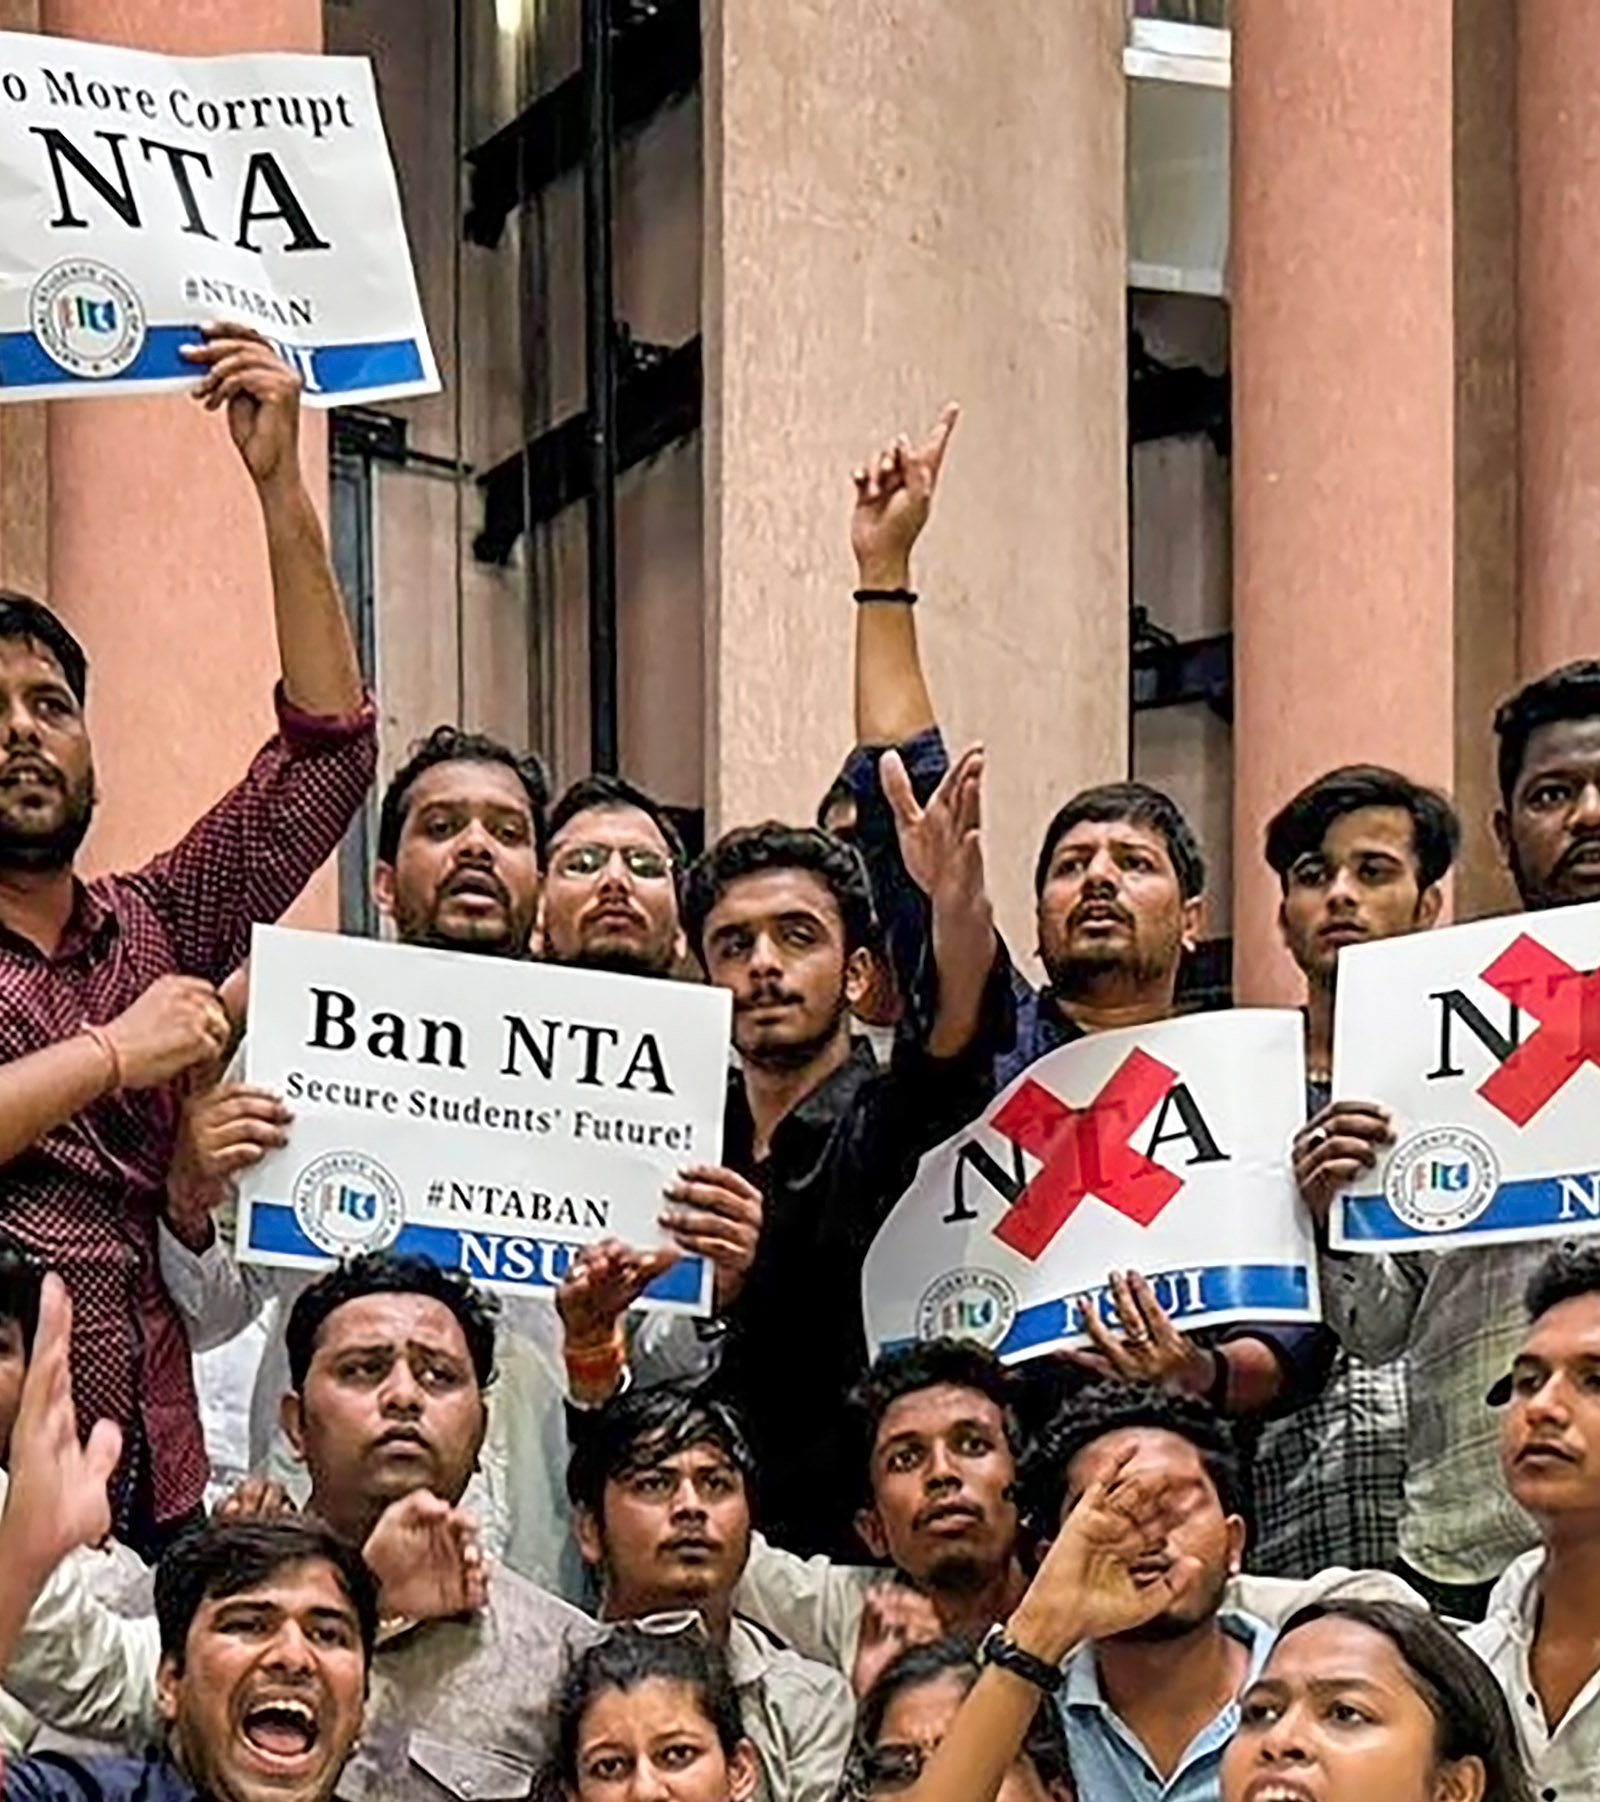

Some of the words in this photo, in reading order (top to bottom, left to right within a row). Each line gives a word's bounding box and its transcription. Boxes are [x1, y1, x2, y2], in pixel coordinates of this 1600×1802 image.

[41, 68, 157, 119] More
[170, 89, 356, 137] Corrupt
[30, 126, 331, 253] NTA
[185, 276, 314, 325] #NTABAN
[307, 988, 466, 1069] Ban
[500, 1015, 674, 1095] NTA
[287, 1072, 399, 1114] Secure
[409, 1090, 561, 1134] Students'
[574, 1111, 693, 1151] Future!
[944, 1082, 1231, 1224] NTA
[426, 1179, 609, 1228] #NTABAN
[459, 1231, 578, 1284] NSU
